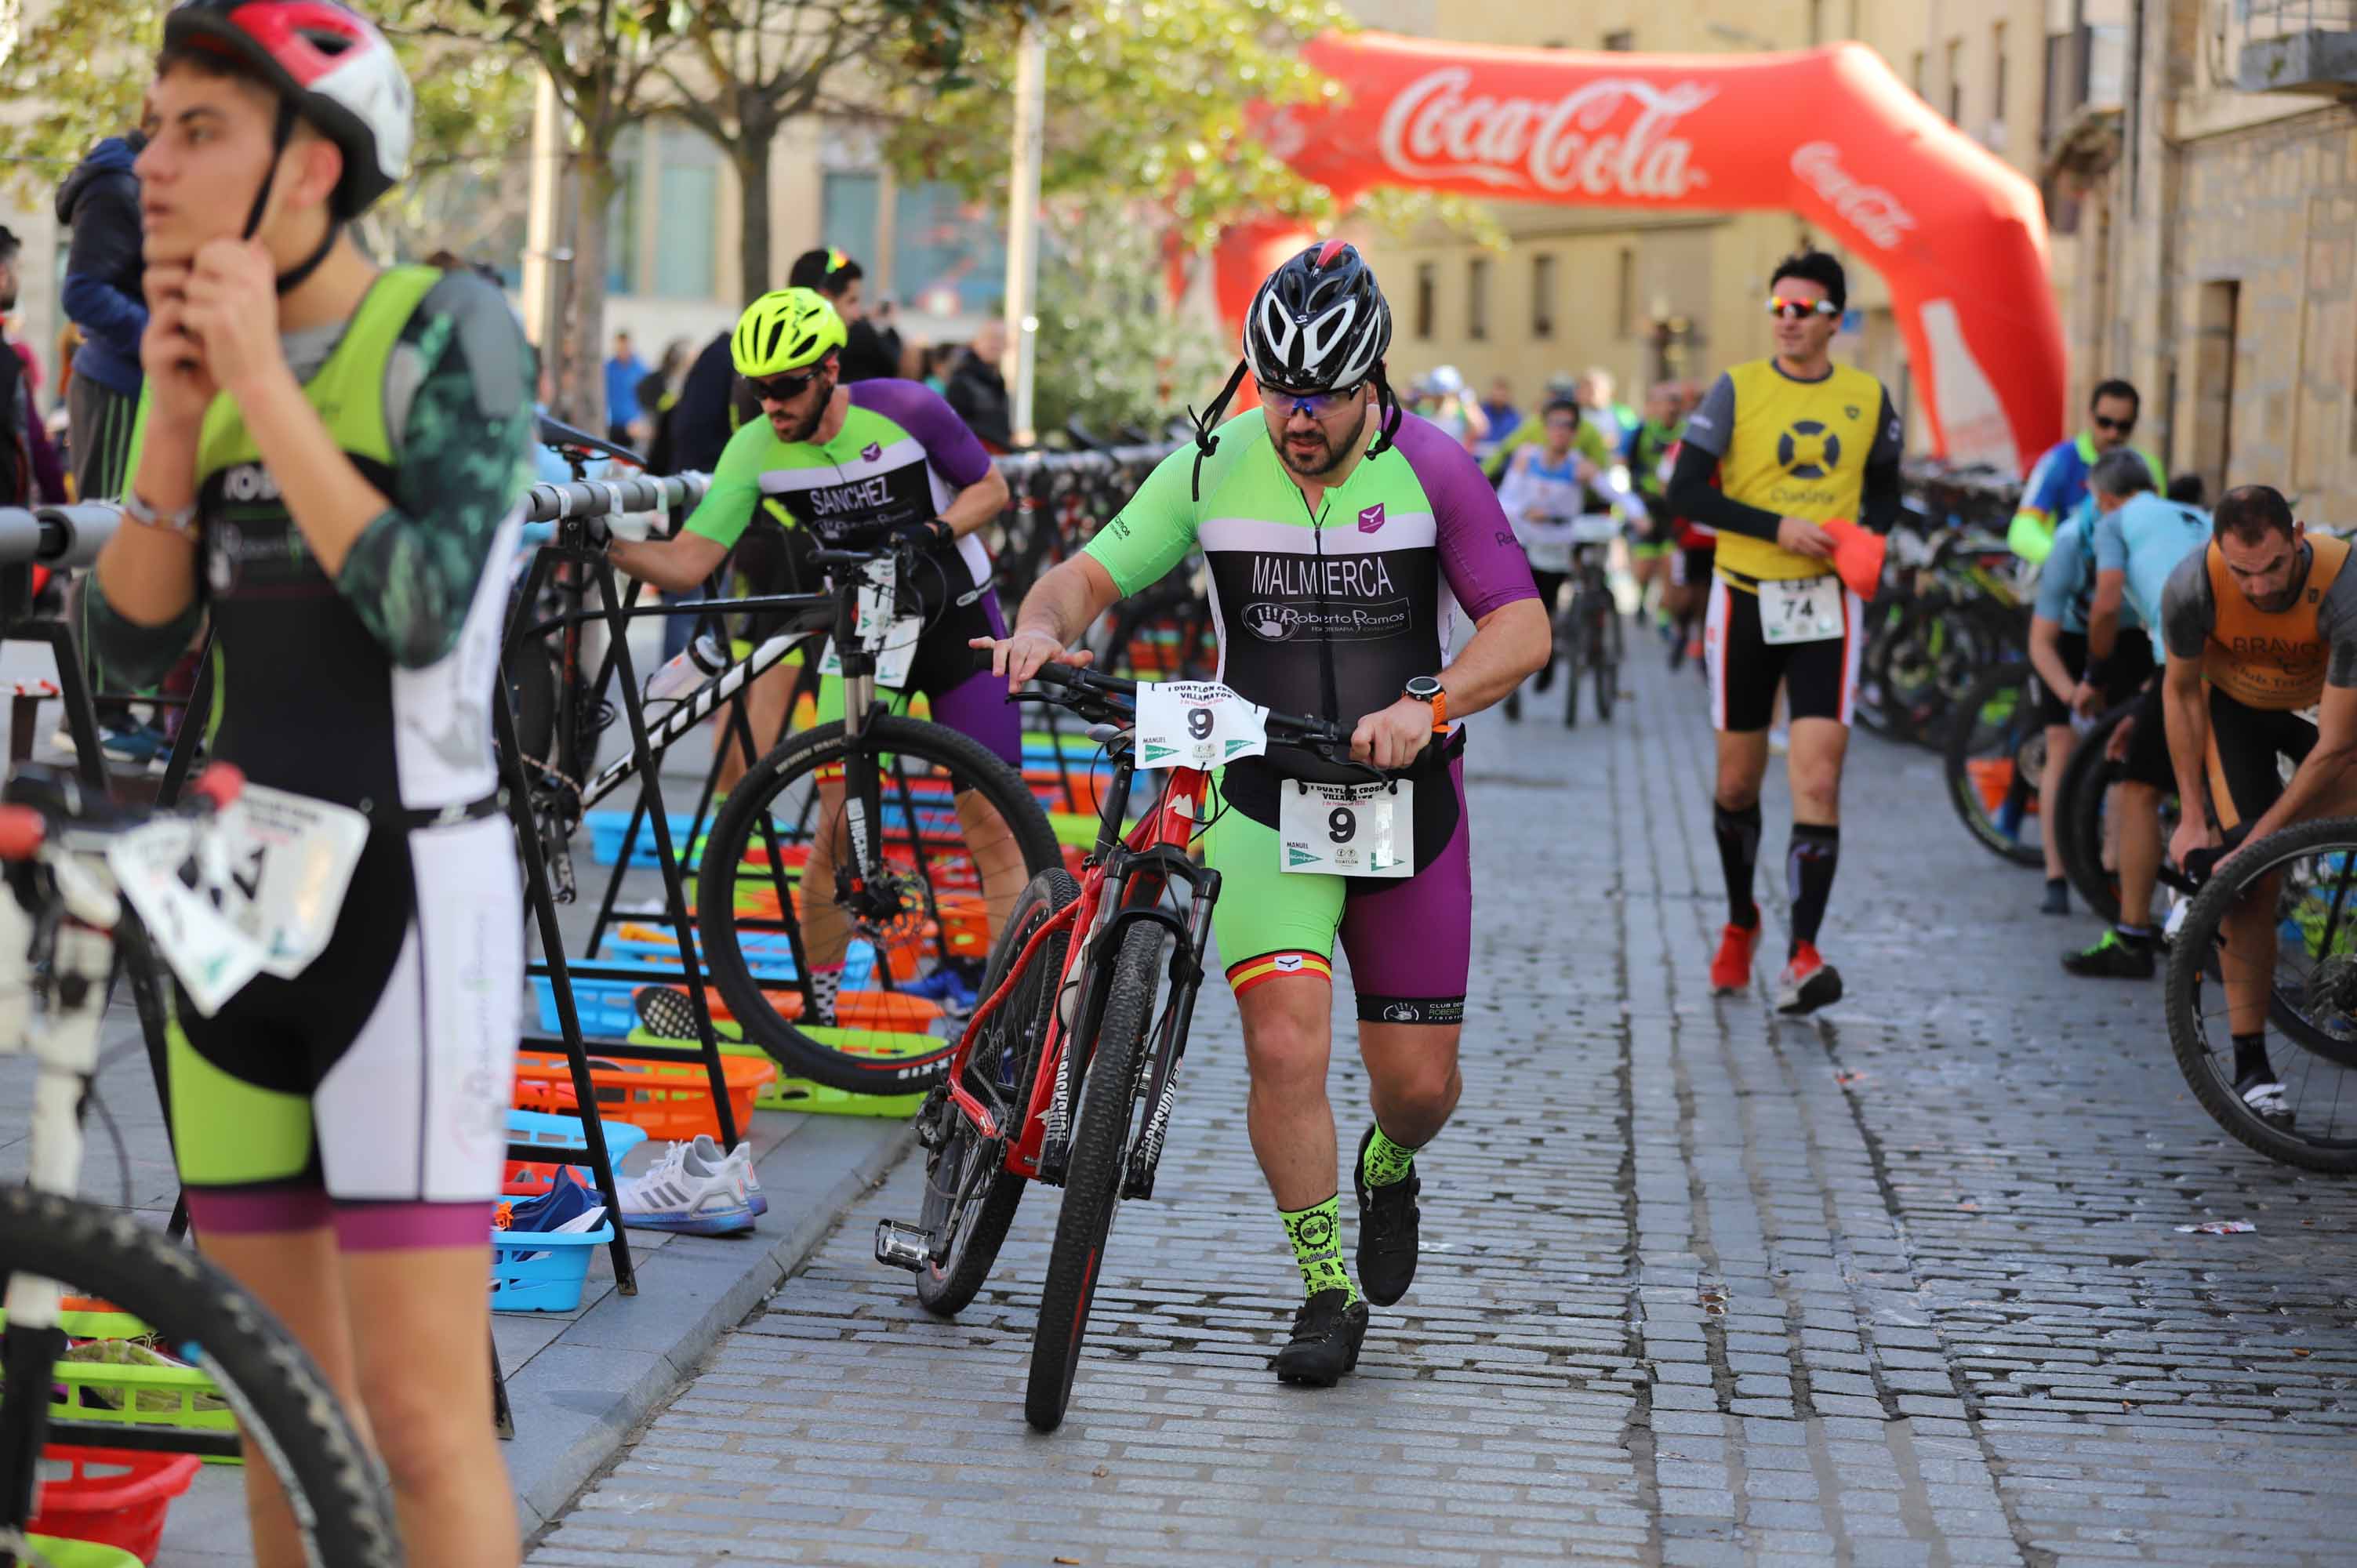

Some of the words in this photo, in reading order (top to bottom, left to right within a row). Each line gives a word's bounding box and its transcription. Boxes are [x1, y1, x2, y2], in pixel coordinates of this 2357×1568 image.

[1252, 555, 1394, 597] MALMIERCA
[1353, 609, 1404, 626] Ramos
[1180, 692, 1233, 702] VILLAMAYOR
[1188, 708, 1214, 740] 9
[1328, 807, 1356, 844] 9
